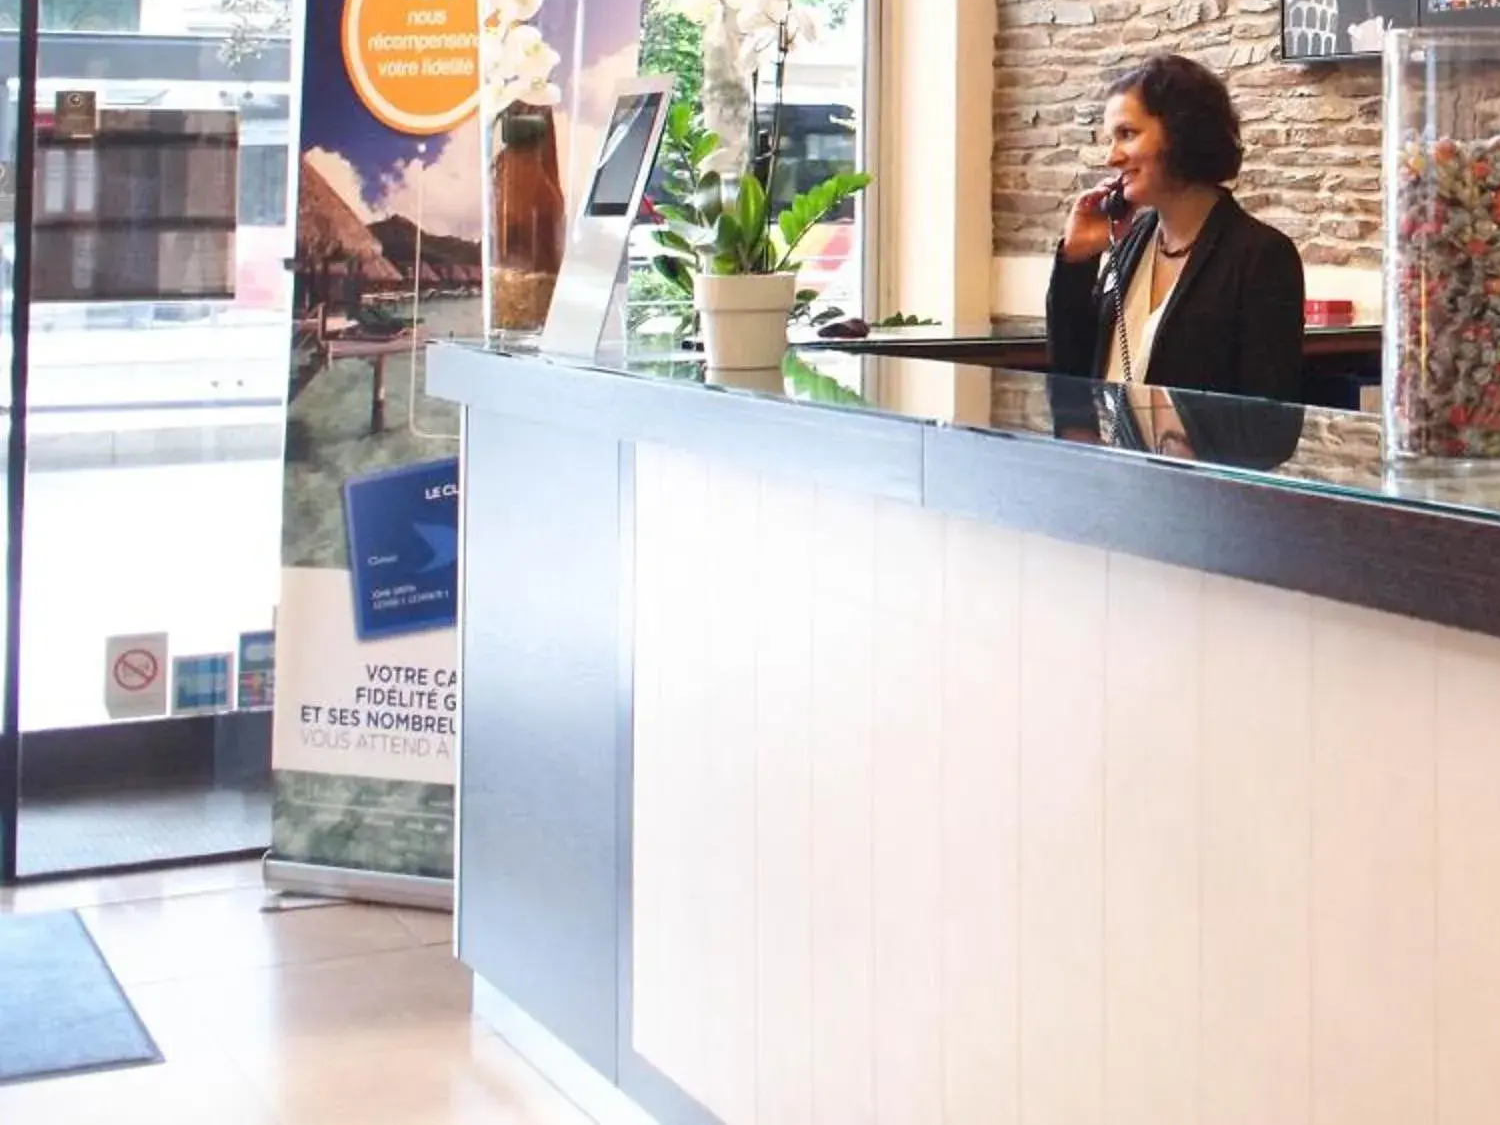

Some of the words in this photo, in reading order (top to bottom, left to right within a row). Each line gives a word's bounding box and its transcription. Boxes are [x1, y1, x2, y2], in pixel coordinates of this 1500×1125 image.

[406, 9, 447, 26] nous
[378, 59, 419, 76] votre
[425, 486, 441, 499] LE
[366, 664, 428, 687] VOTRE
[355, 686, 437, 710] FIDÉLITÉ
[300, 705, 320, 723] ET
[327, 708, 360, 727] SES
[300, 729, 352, 750] VOUS
[355, 734, 431, 757] ATTEND
